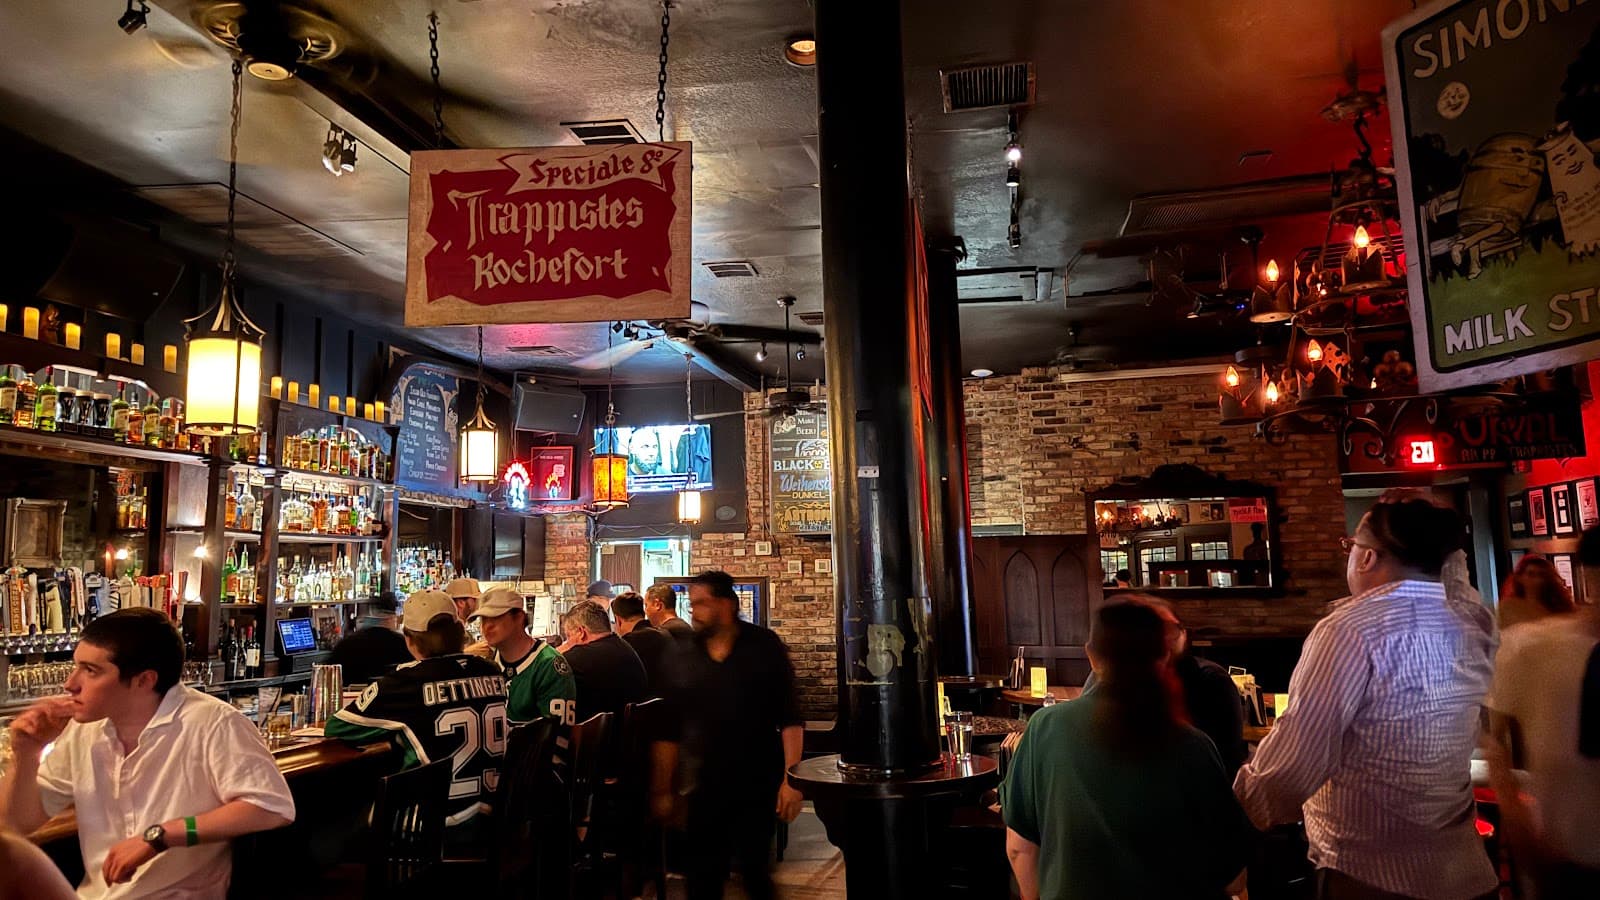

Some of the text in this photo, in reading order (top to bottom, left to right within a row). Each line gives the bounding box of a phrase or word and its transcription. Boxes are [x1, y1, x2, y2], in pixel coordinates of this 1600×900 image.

[528, 153, 634, 187] Speciale
[447, 189, 644, 250] Trappistes
[467, 248, 629, 291] Rochefort
[1444, 288, 1600, 355] MILK ST
[774, 460, 815, 471] BLACK
[550, 698, 576, 726] 96
